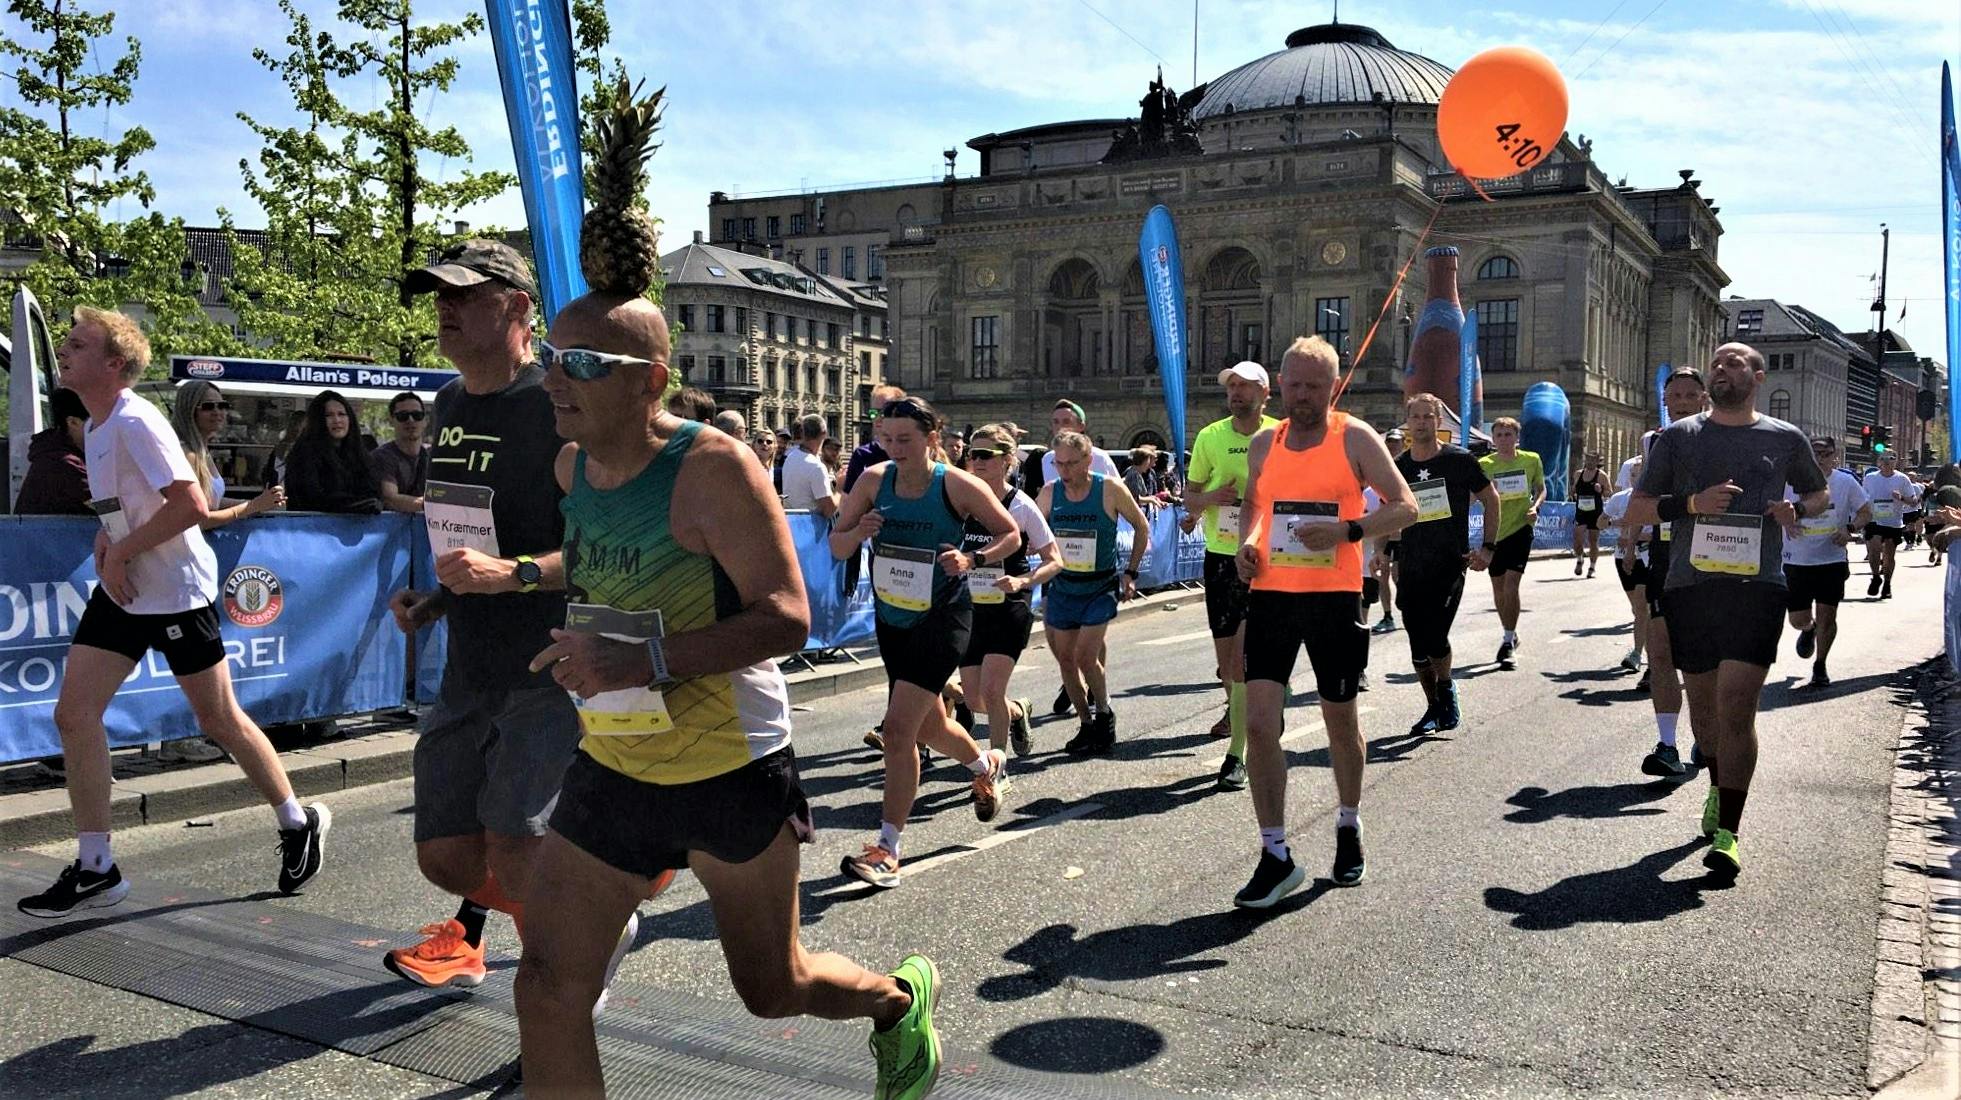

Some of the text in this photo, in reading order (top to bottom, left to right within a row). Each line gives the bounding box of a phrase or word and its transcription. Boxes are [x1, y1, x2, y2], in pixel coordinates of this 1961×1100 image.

[1496, 123, 1541, 167] 4:10
[285, 367, 419, 388] Allan's Pølser
[438, 426, 464, 447] DO
[467, 450, 494, 472] IT
[441, 519, 492, 536] Kræmmer
[1706, 532, 1749, 544] Rasmus
[226, 568, 278, 594] ERDINGER
[890, 567, 914, 579] Anna
